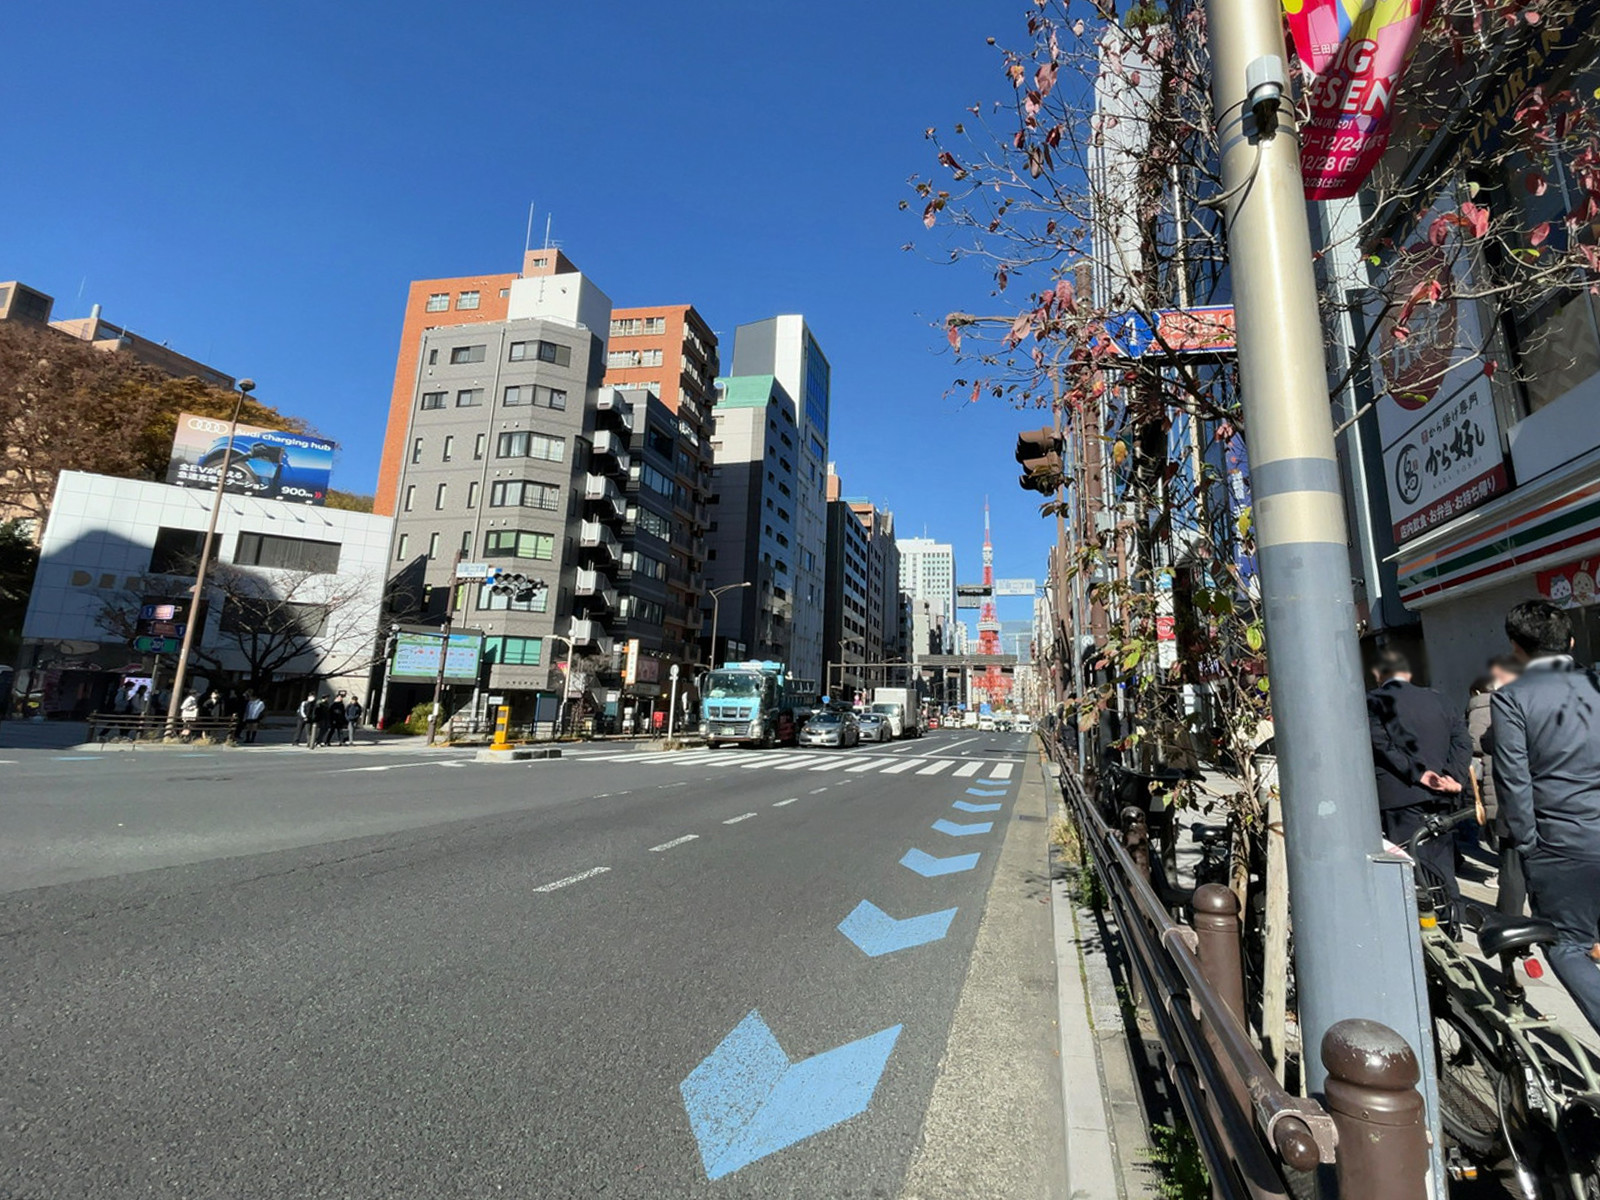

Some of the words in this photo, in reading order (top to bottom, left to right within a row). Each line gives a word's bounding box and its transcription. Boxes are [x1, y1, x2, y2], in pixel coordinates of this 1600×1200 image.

[235, 428, 260, 438] Audi
[262, 433, 309, 448] charging
[310, 442, 331, 452] hub
[179, 463, 243, 480] 全EVがえる
